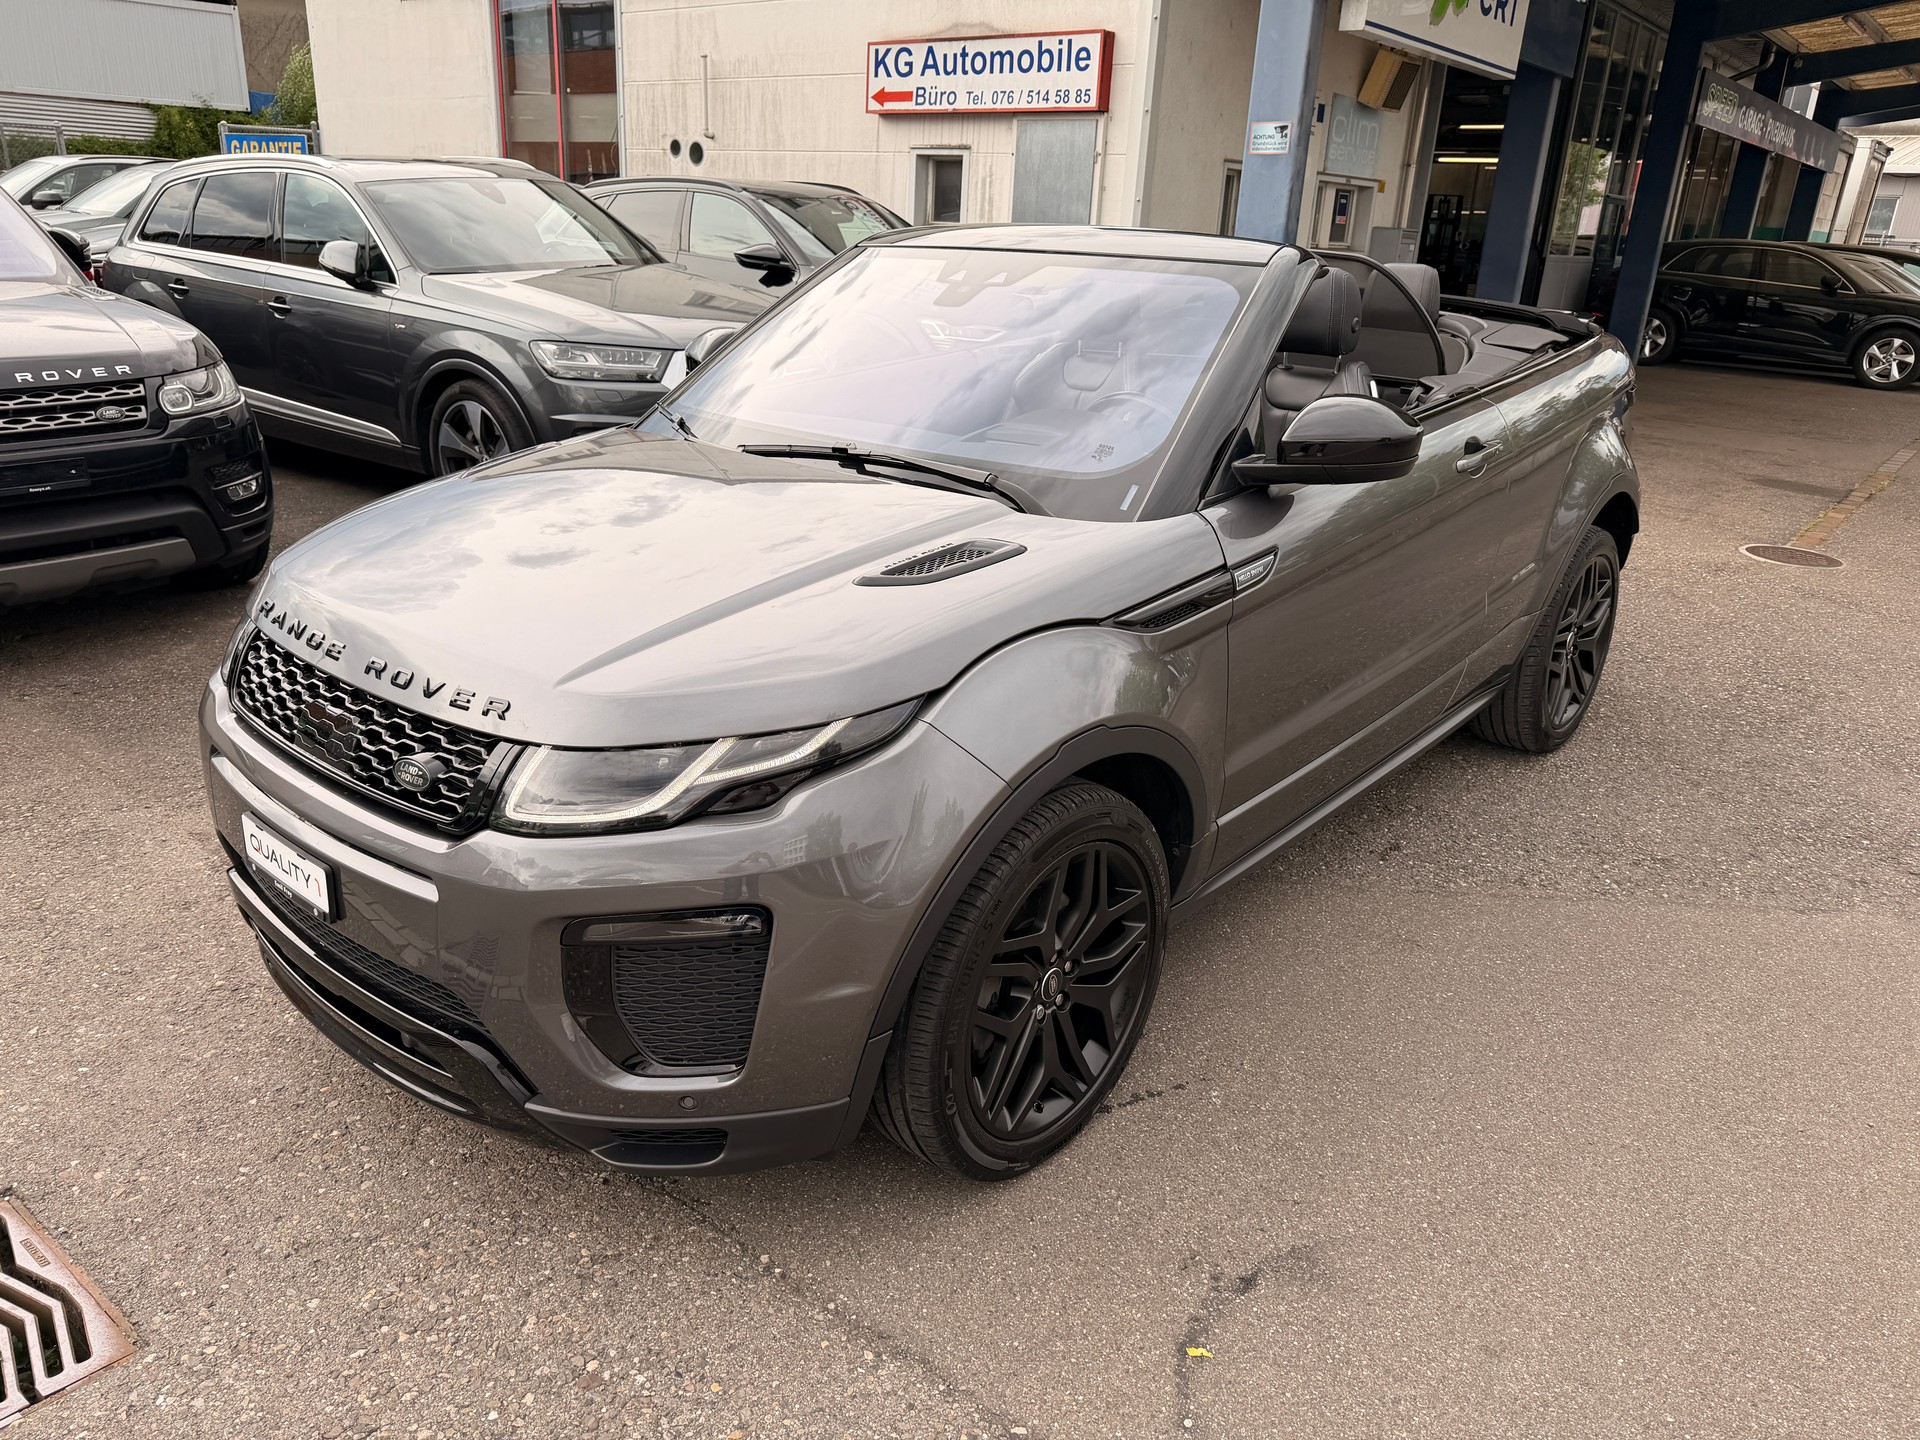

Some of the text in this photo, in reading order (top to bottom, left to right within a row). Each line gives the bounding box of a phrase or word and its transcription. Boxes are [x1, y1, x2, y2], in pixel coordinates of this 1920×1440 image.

[874, 38, 1092, 78] KG Automobile
[914, 86, 957, 107] Büro
[966, 91, 987, 106] Tel.
[991, 90, 1014, 105] 076
[1026, 89, 1050, 105] 514
[1054, 89, 1070, 104] 58
[1075, 88, 1091, 104] 85
[1702, 82, 1740, 124] SPEED
[1738, 105, 1765, 136] GARAGE
[230, 139, 302, 154] GARANTIE
[14, 364, 133, 383] ROVER
[258, 598, 512, 721] RANGE ROVER
[399, 761, 419, 776] LAND
[400, 772, 424, 786] ROVER
